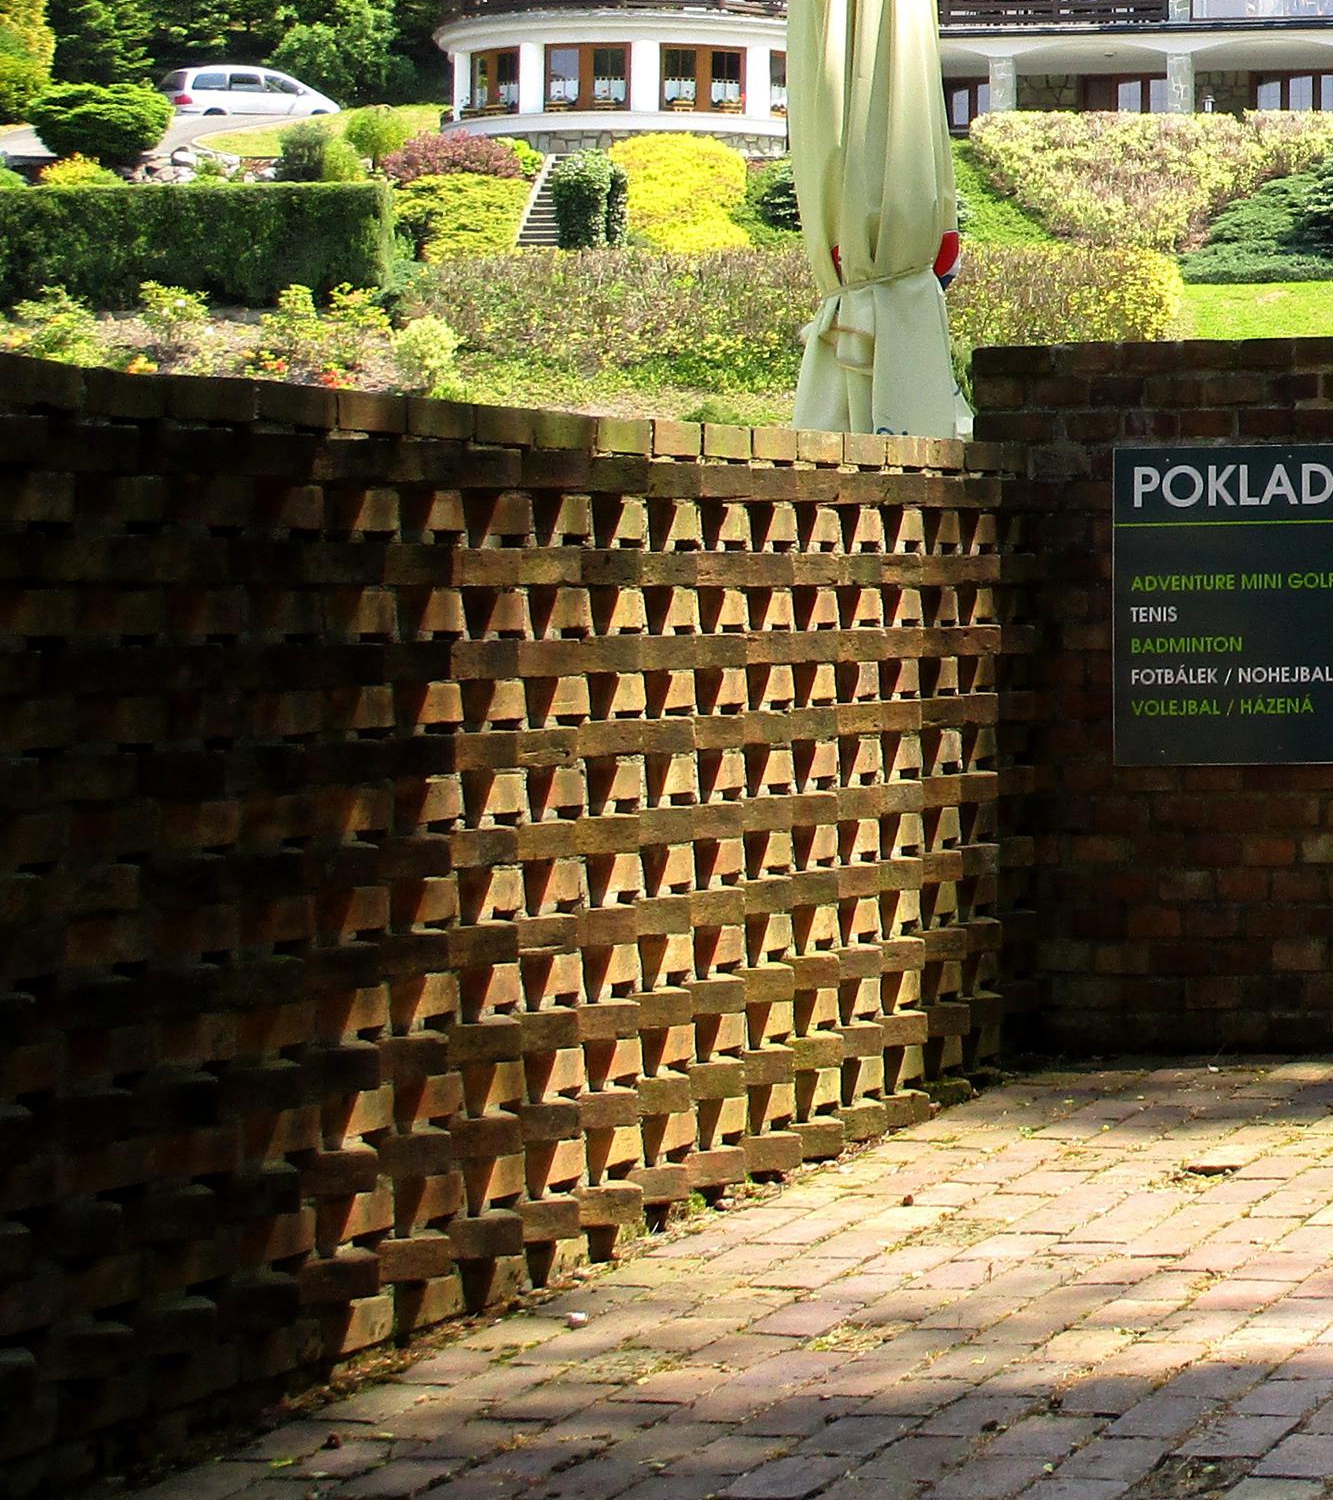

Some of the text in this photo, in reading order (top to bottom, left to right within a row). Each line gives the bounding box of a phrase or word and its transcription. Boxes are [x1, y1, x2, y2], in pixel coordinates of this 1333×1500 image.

[1131, 574, 1235, 591] ADVENTURE
[1241, 573, 1282, 590] MINI
[1130, 606, 1178, 623] TENIS
[1131, 636, 1243, 654] BADMINTON
[1131, 664, 1218, 685] FOTBÁLEK
[1238, 666, 1333, 683] NOHEJBAL
[1131, 699, 1221, 716] VOLEJBAL
[1240, 694, 1315, 714] HÁZENÁ
